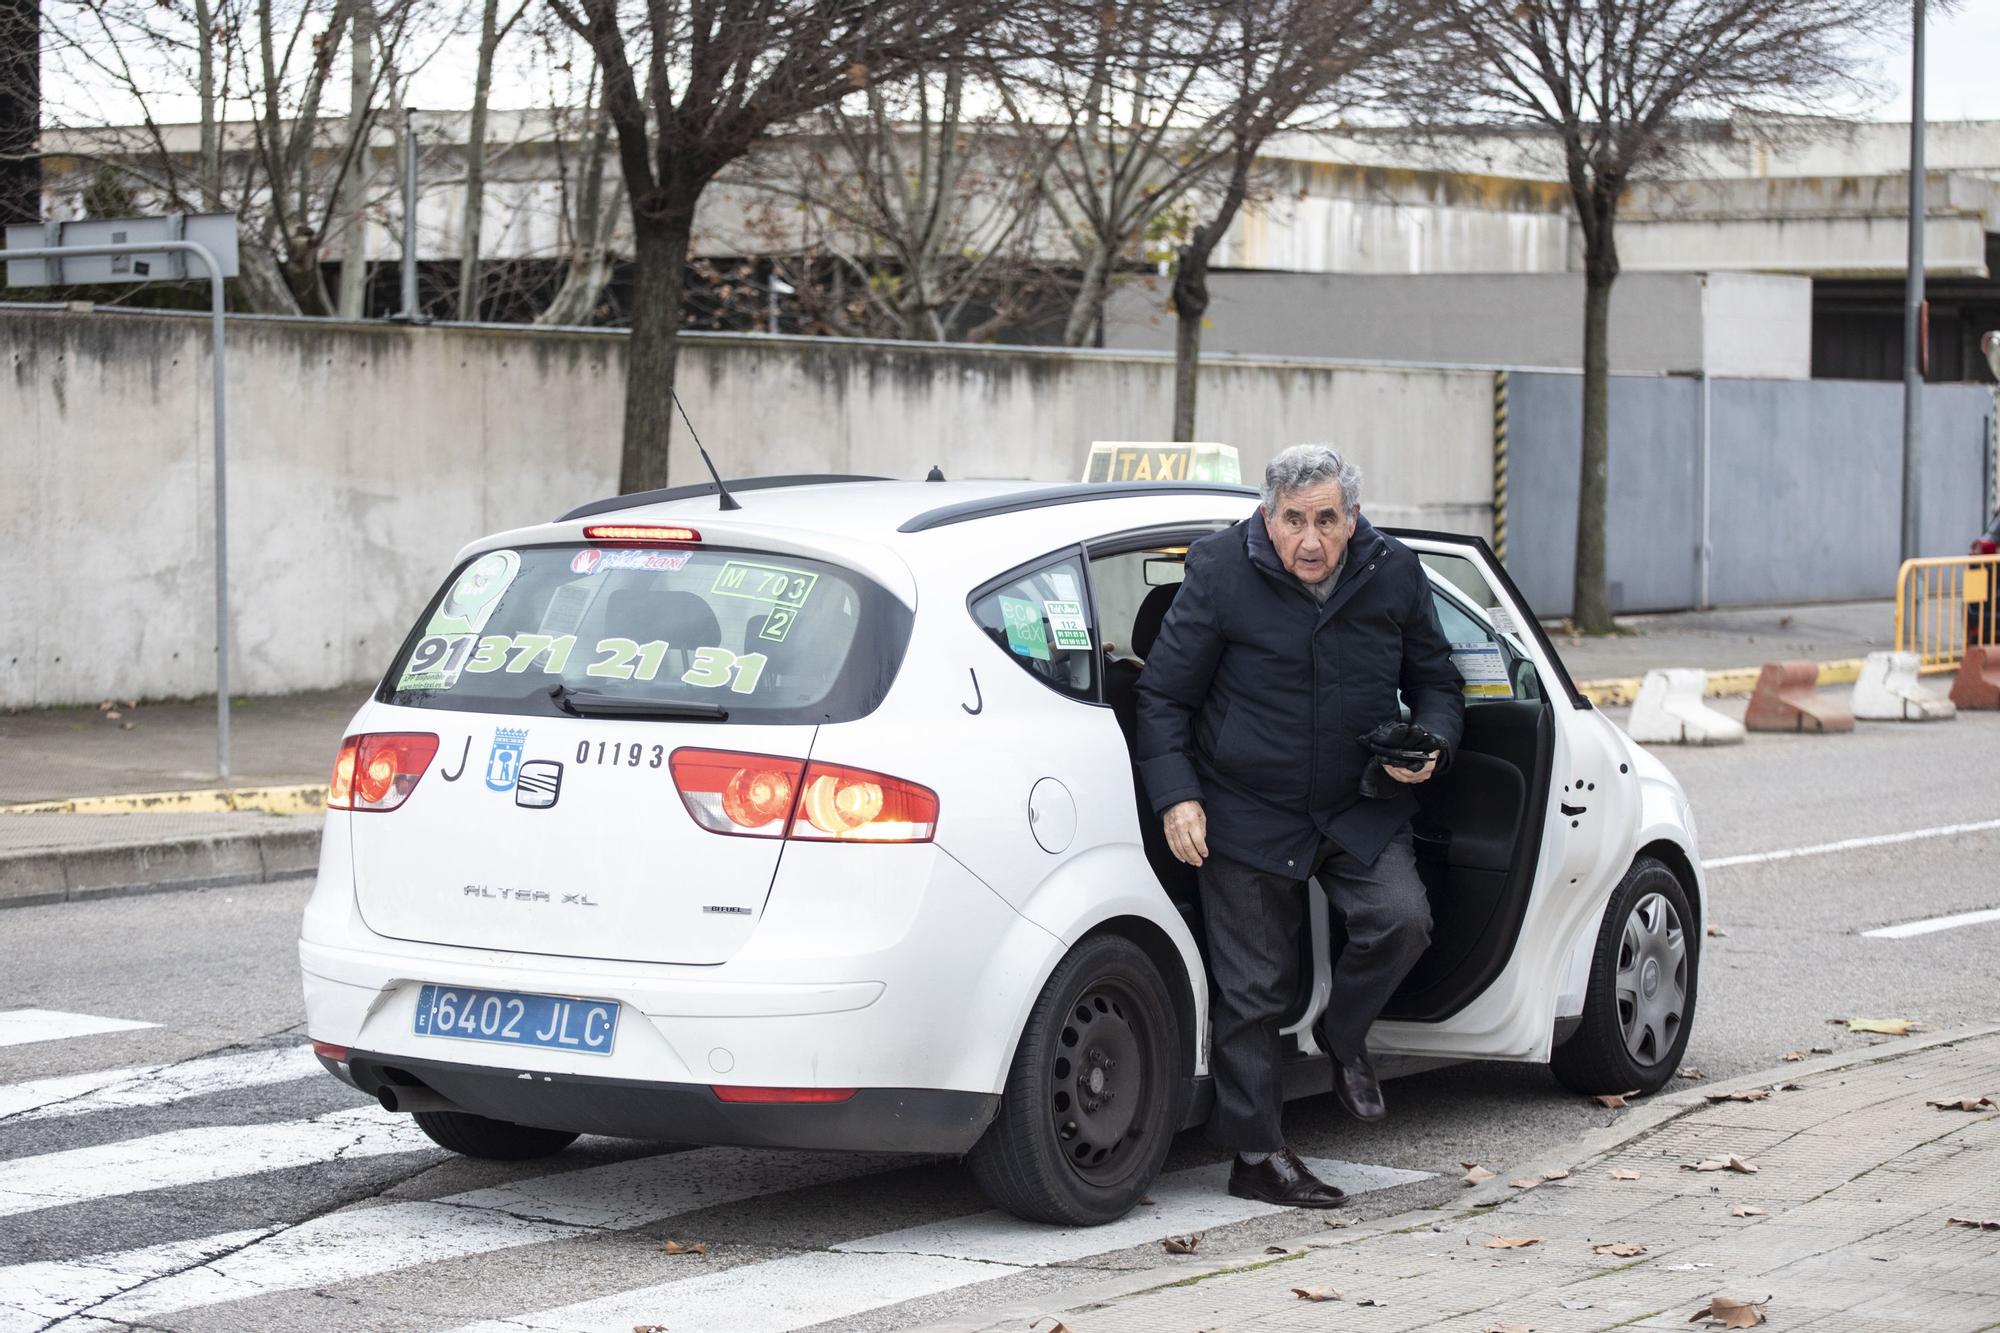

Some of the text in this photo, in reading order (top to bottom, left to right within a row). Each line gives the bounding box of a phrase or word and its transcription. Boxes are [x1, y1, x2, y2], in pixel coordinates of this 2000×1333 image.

[1119, 453, 1187, 481] TAXI
[721, 567, 806, 599] M 703
[766, 612, 789, 636] 2
[1003, 601, 1037, 623] eco
[1061, 620, 1078, 629] 112
[1014, 617, 1046, 643] taxi
[411, 634, 768, 694] 91 371 21 31
[440, 735, 472, 782] J
[575, 740, 664, 769] 01193
[463, 885, 599, 906] ALTEA XL
[419, 1015, 425, 1026] E
[437, 992, 608, 1047] 6402 JLC
